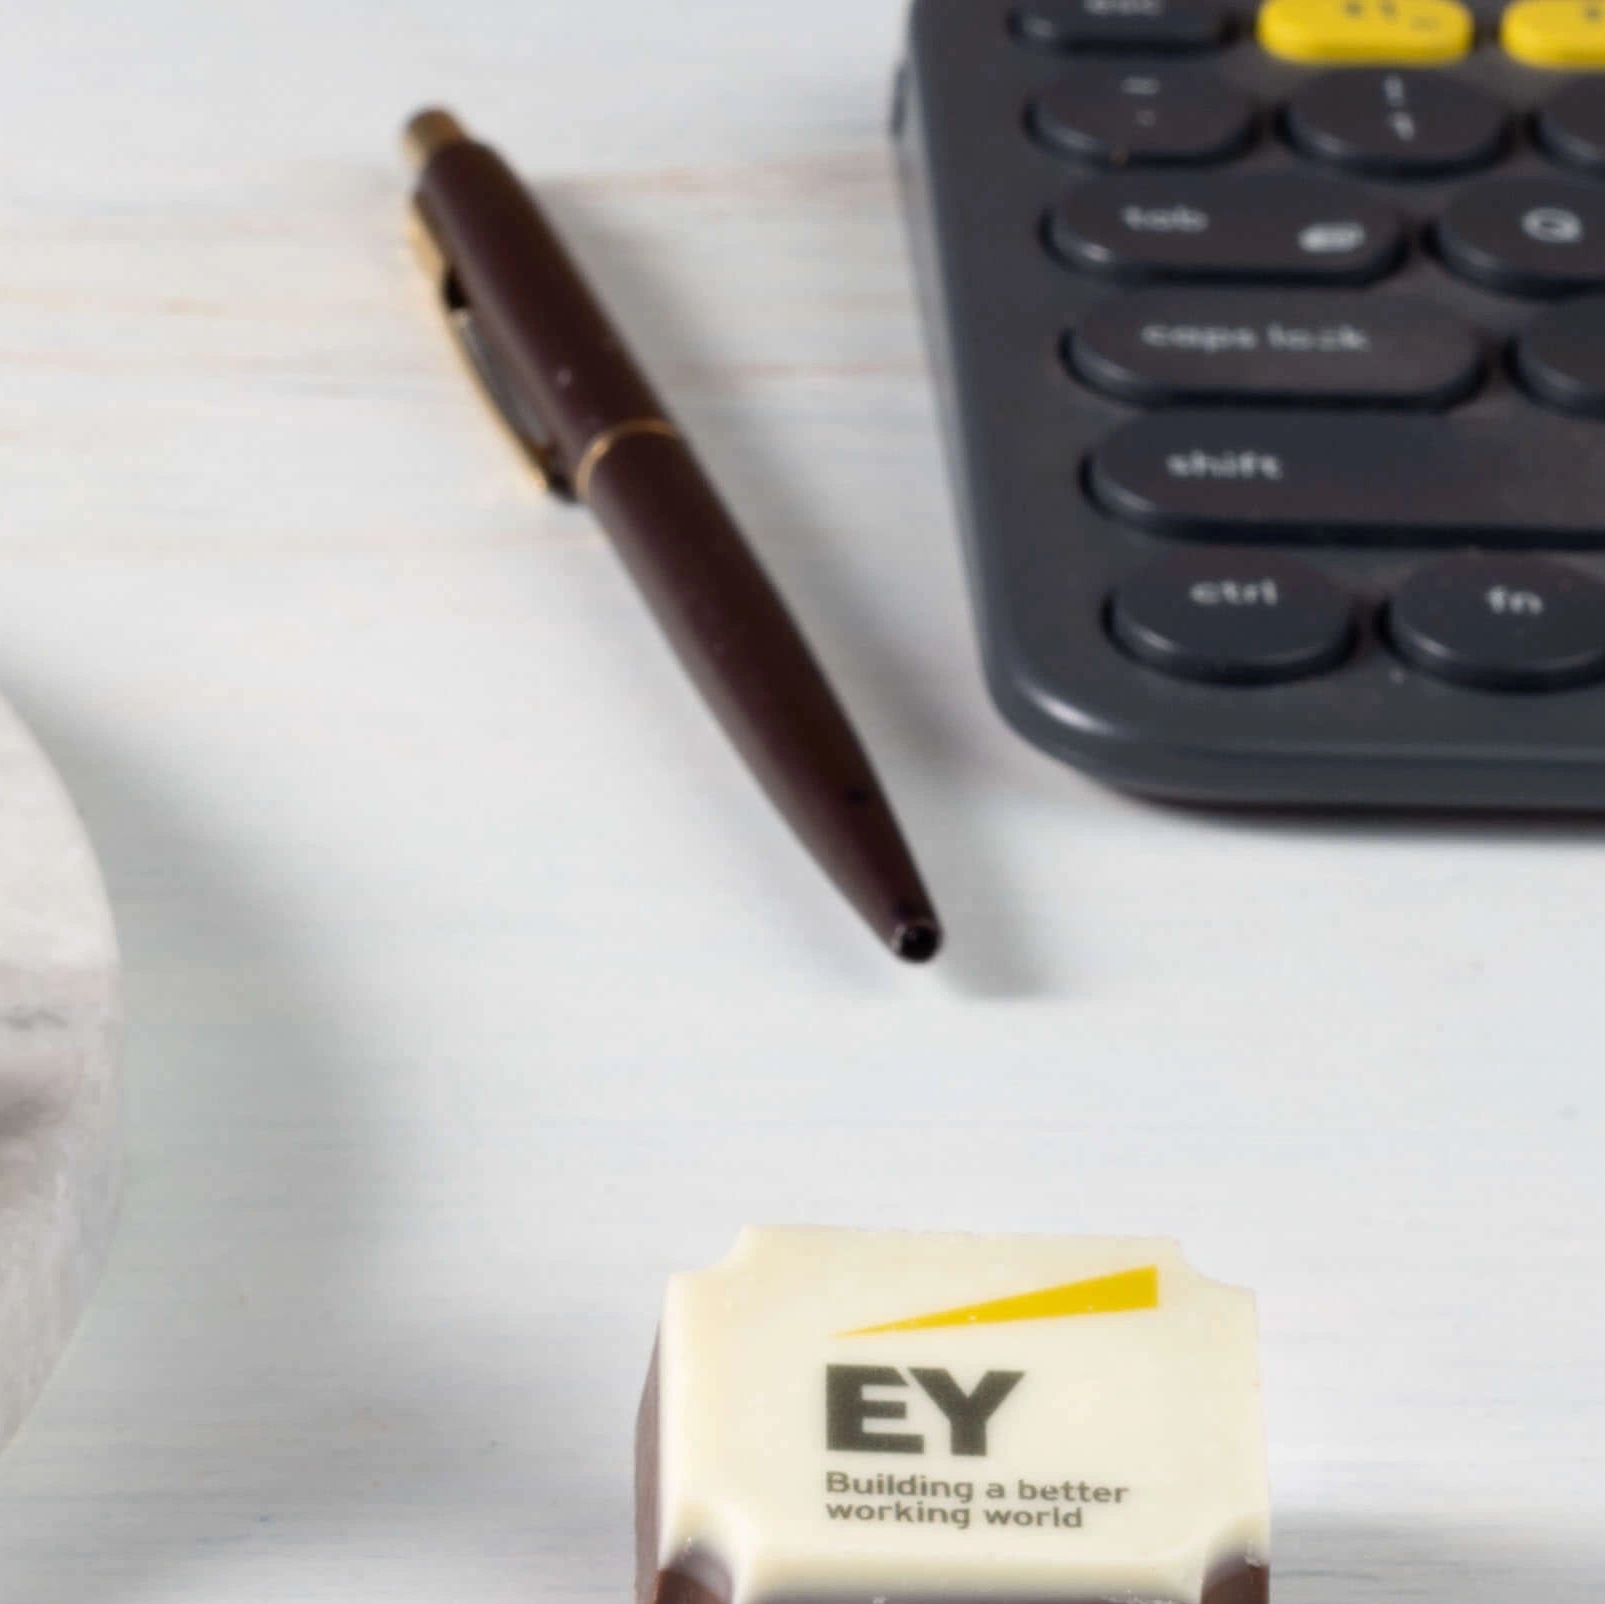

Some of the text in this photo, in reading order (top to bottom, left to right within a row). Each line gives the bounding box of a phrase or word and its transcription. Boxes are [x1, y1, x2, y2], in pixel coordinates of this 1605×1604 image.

[1123, 205, 1207, 233] tab
[1167, 450, 1283, 480] shift
[1190, 579, 1279, 606] ctrl
[1486, 585, 1543, 615] fn
[825, 1363, 1027, 1457] EY
[825, 1470, 1130, 1504] Building a better
[826, 1501, 1084, 1530] working world
